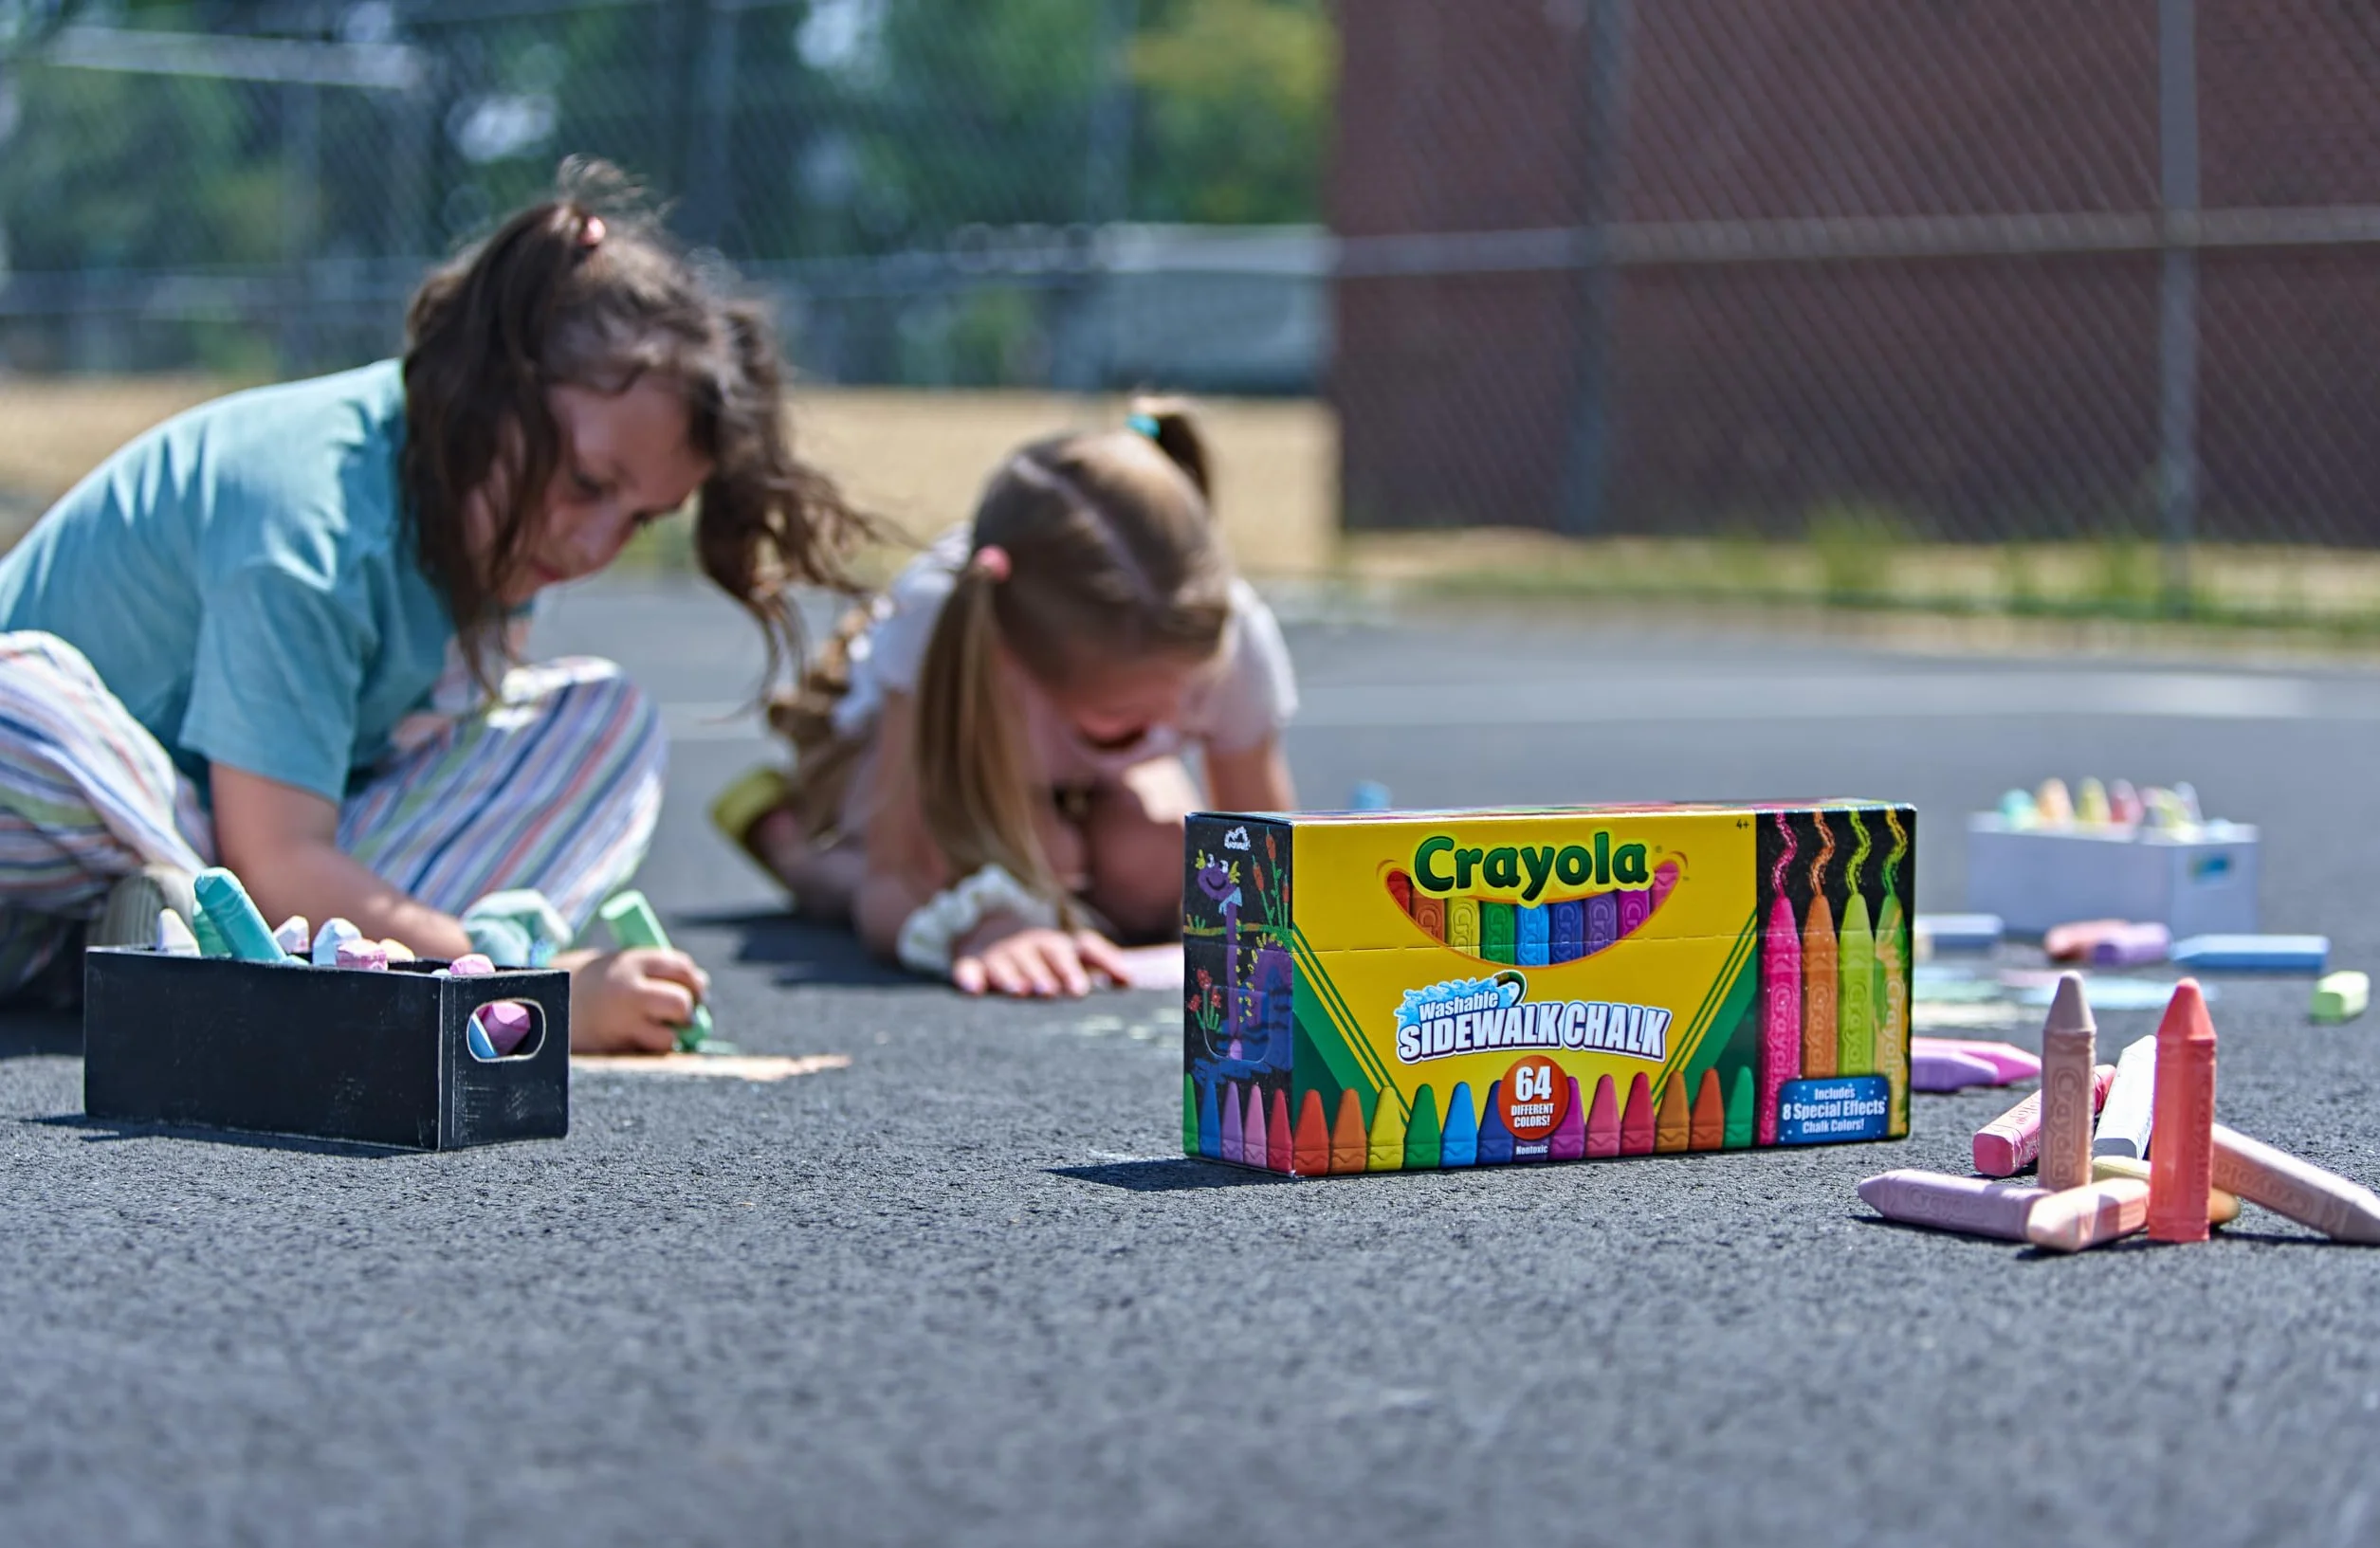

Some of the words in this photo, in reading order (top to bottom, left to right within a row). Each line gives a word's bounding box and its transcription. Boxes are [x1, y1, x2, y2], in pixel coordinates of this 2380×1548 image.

[1736, 819, 1750, 829] 4+
[1415, 831, 1649, 901] Crayola
[1419, 991, 1500, 1023] Washable
[1399, 1003, 1565, 1060] SIDEWALK
[1563, 1002, 1670, 1059] CHALK
[1807, 984, 1830, 1073] Crayol
[1844, 981, 1867, 1071] Crayol
[1515, 1065, 1552, 1102] 64
[1815, 1086, 1856, 1101] Includes
[1510, 1102, 1555, 1118] DIFFERENT
[1782, 1103, 1791, 1120] 8
[1793, 1102, 1841, 1120] Special
[1843, 1100, 1885, 1117] Effects
[1513, 1115, 1551, 1128] COLORS!
[1803, 1120, 1830, 1135] Chalk
[1831, 1119, 1865, 1133] Colors!
[1515, 1145, 1549, 1156] Nontoxic
